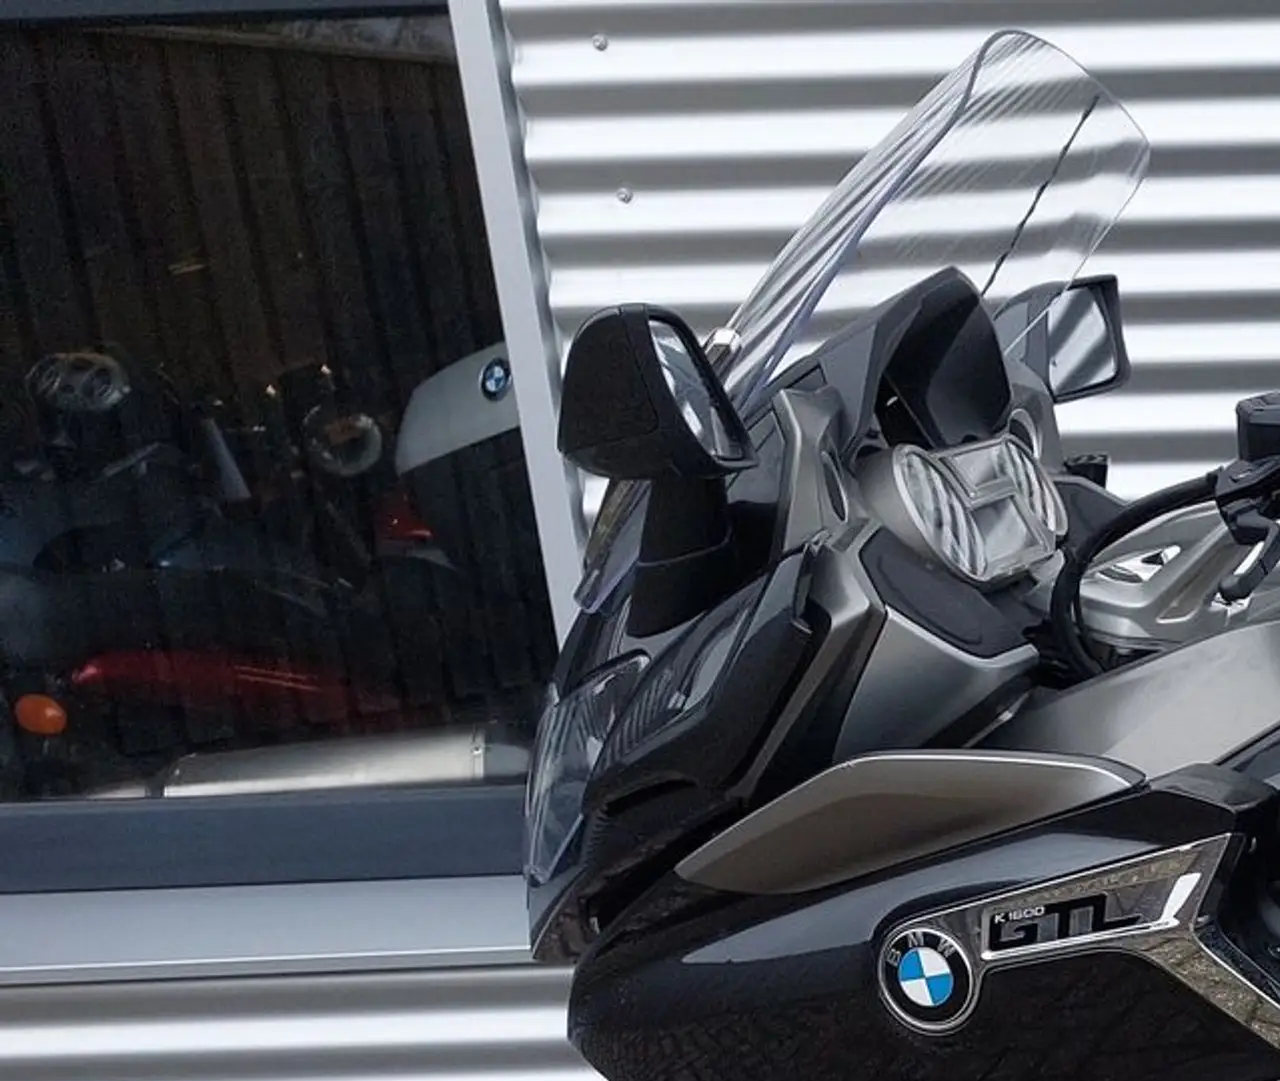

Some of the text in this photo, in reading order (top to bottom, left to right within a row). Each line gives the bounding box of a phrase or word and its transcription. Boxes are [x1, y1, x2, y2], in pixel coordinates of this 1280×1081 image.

[989, 893, 1142, 950] GTL
[994, 914, 1005, 924] K
[885, 929, 957, 967] BMW
